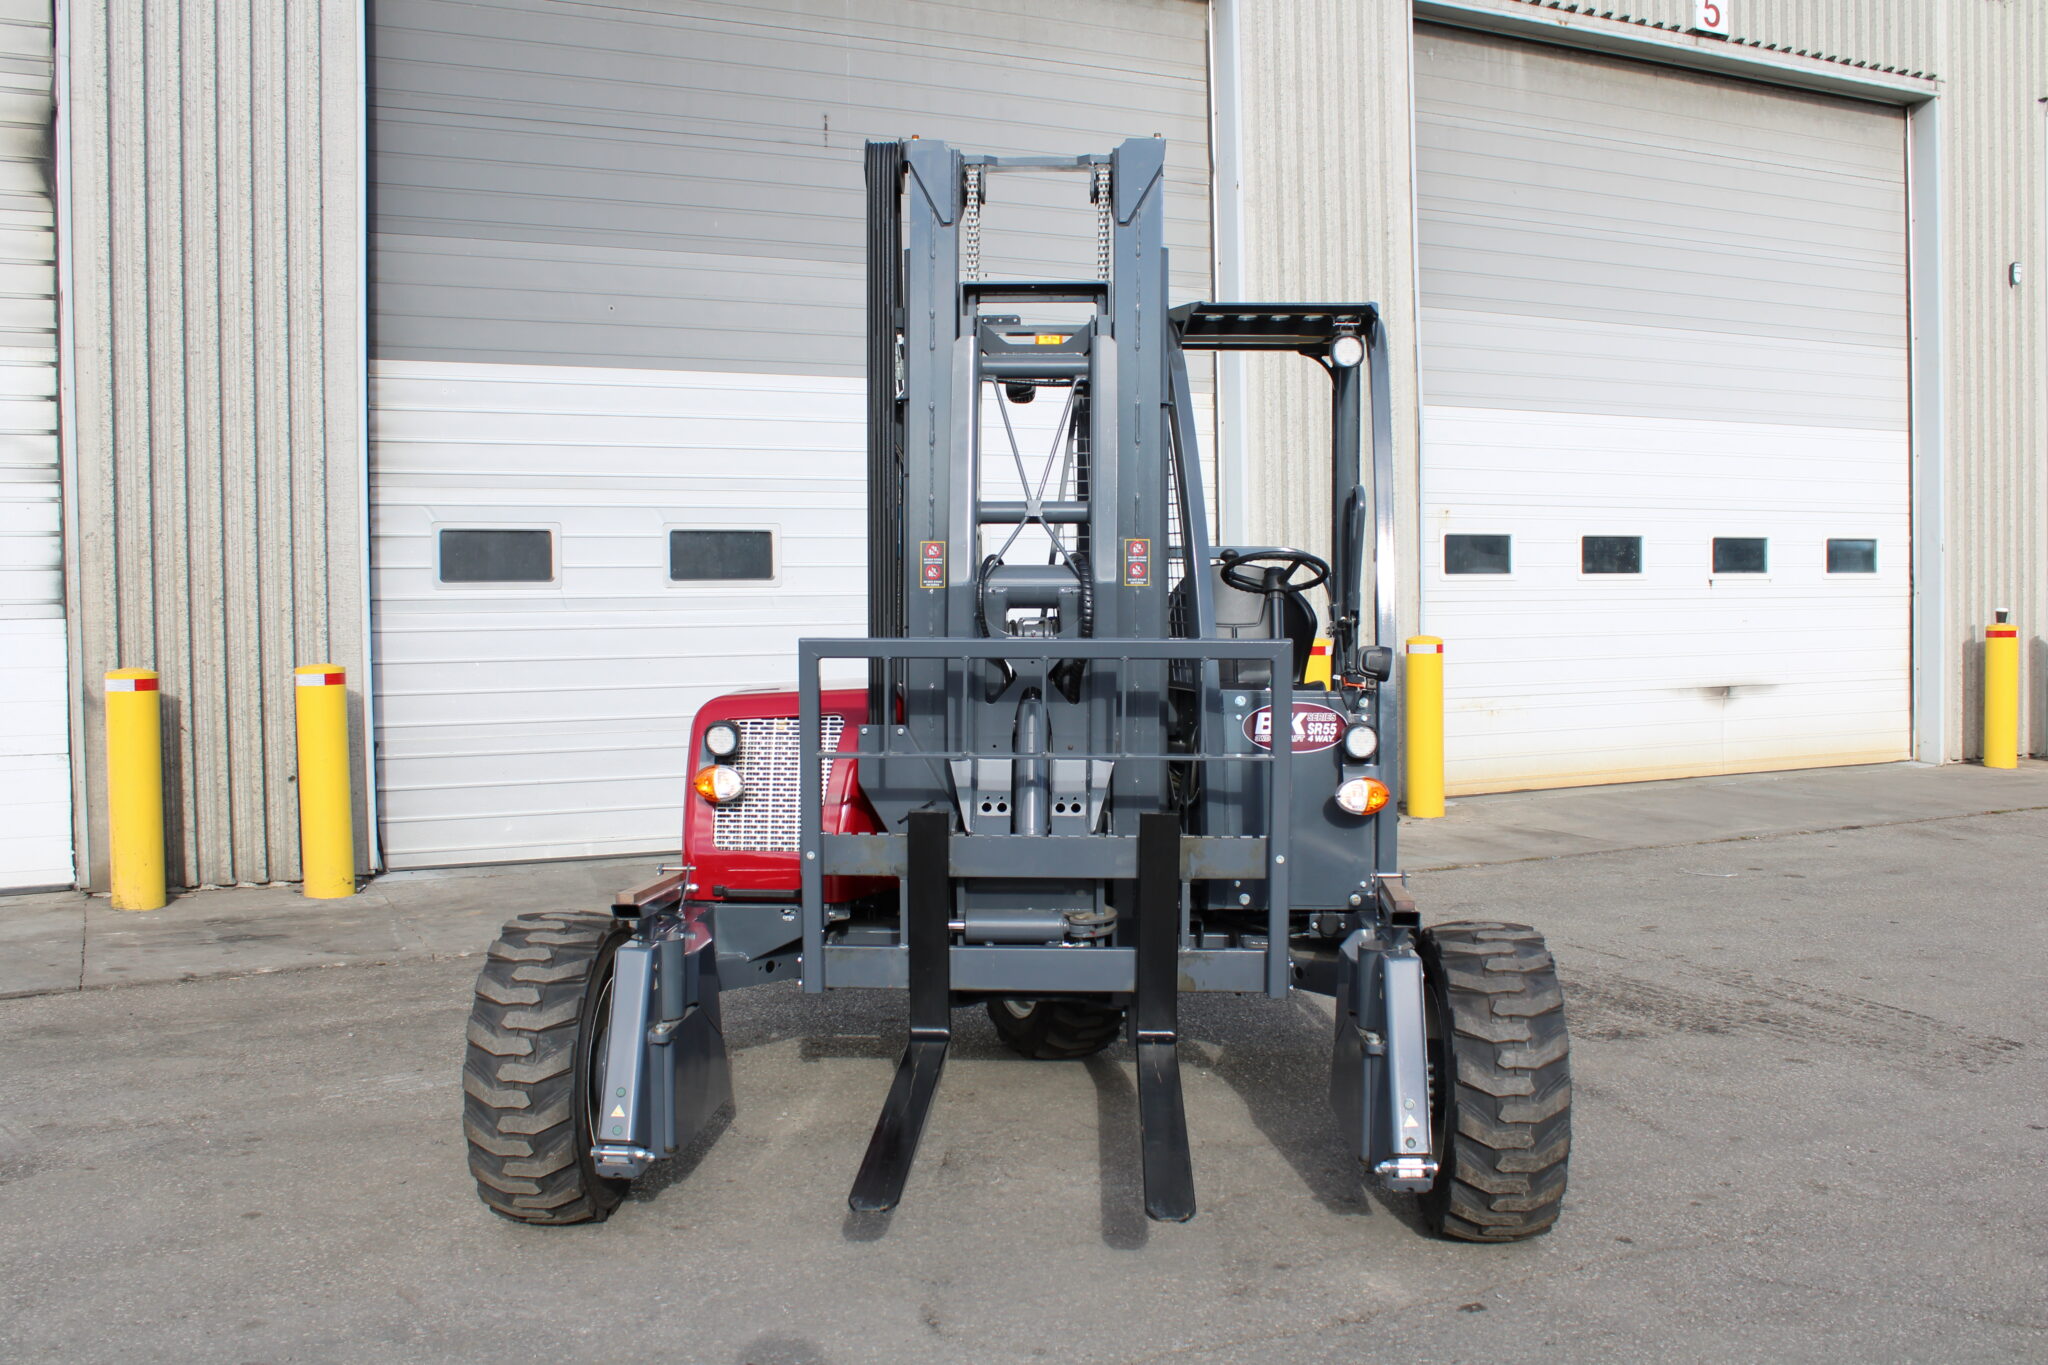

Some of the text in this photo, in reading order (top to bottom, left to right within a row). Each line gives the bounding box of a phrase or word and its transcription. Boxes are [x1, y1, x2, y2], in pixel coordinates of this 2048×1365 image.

[1704, 0, 1720, 28] 5
[1307, 713, 1337, 721] SERIES
[1307, 723, 1337, 735] SR55
